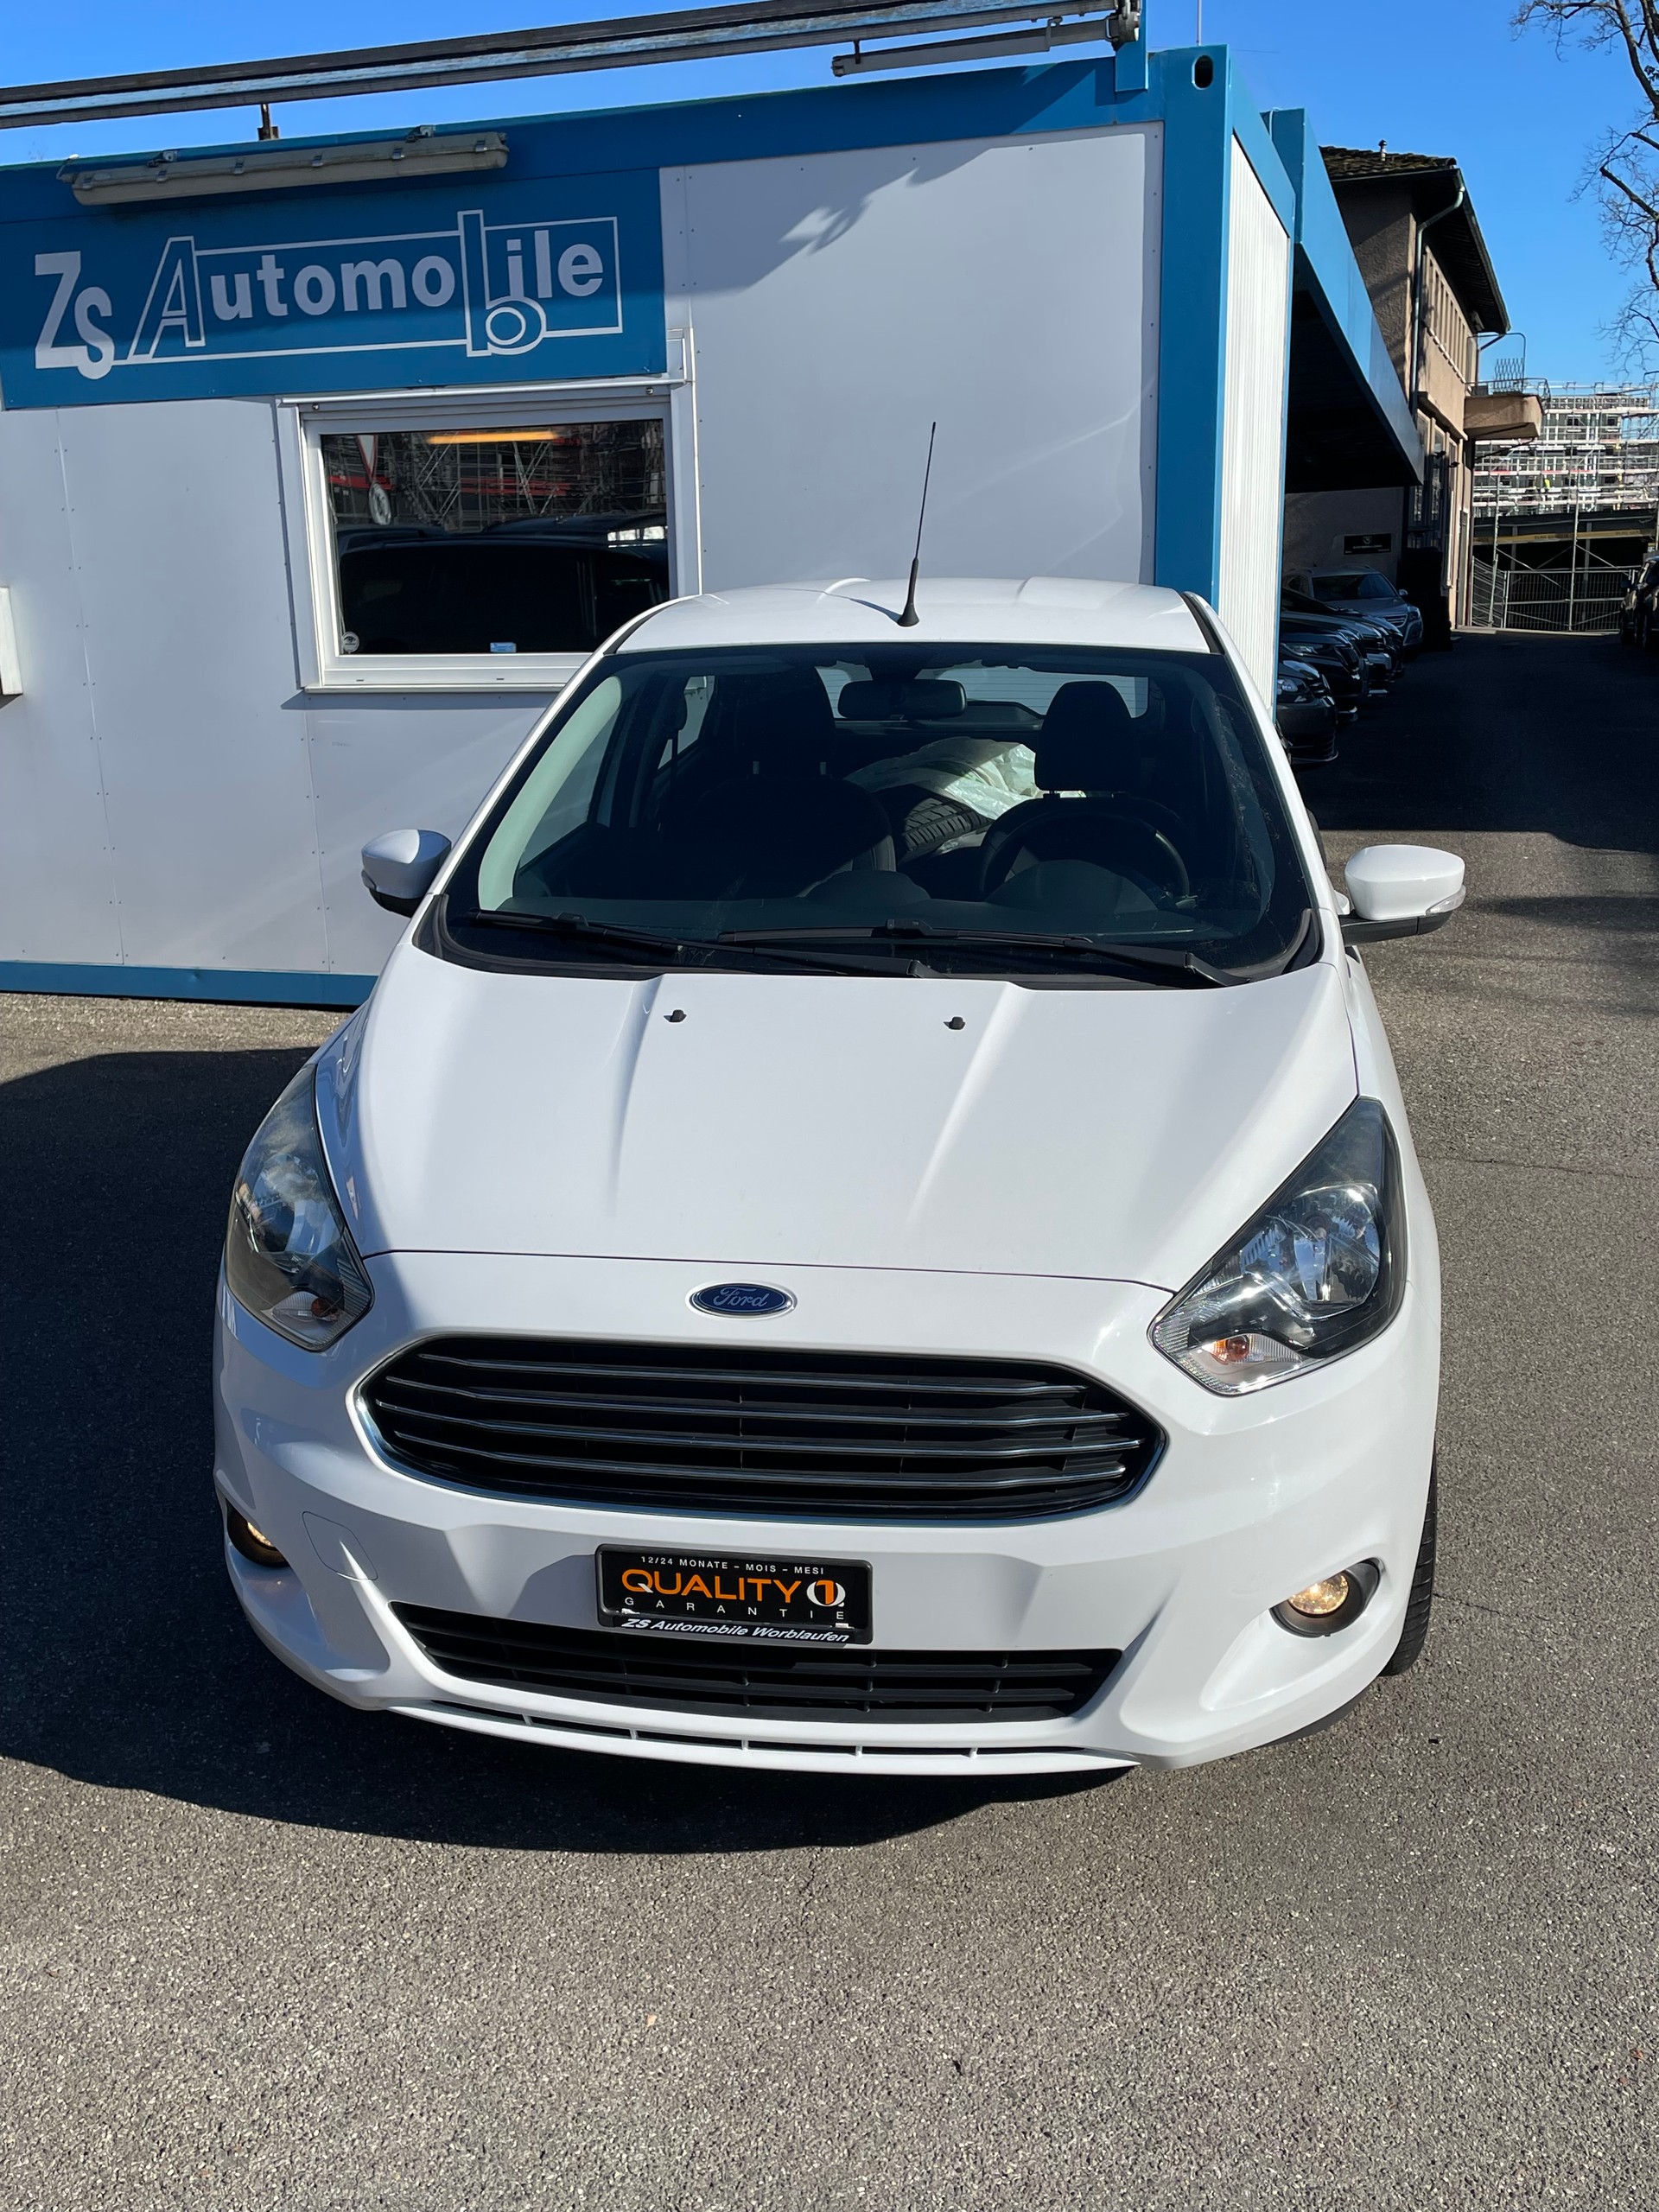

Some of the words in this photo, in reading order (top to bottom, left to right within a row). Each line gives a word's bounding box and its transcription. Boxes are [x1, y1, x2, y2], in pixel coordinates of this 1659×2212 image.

[127, 209, 604, 358] Automobile
[713, 1287, 770, 1307] Ford
[640, 1556, 673, 1566] 12/24
[679, 1559, 728, 1569] MONATE
[621, 1569, 802, 1603] QUALITY
[625, 1597, 844, 1620] GARANTIE
[621, 1618, 652, 1629] ZS
[651, 1620, 749, 1636] Automobile
[752, 1628, 849, 1642] Worblaufen
